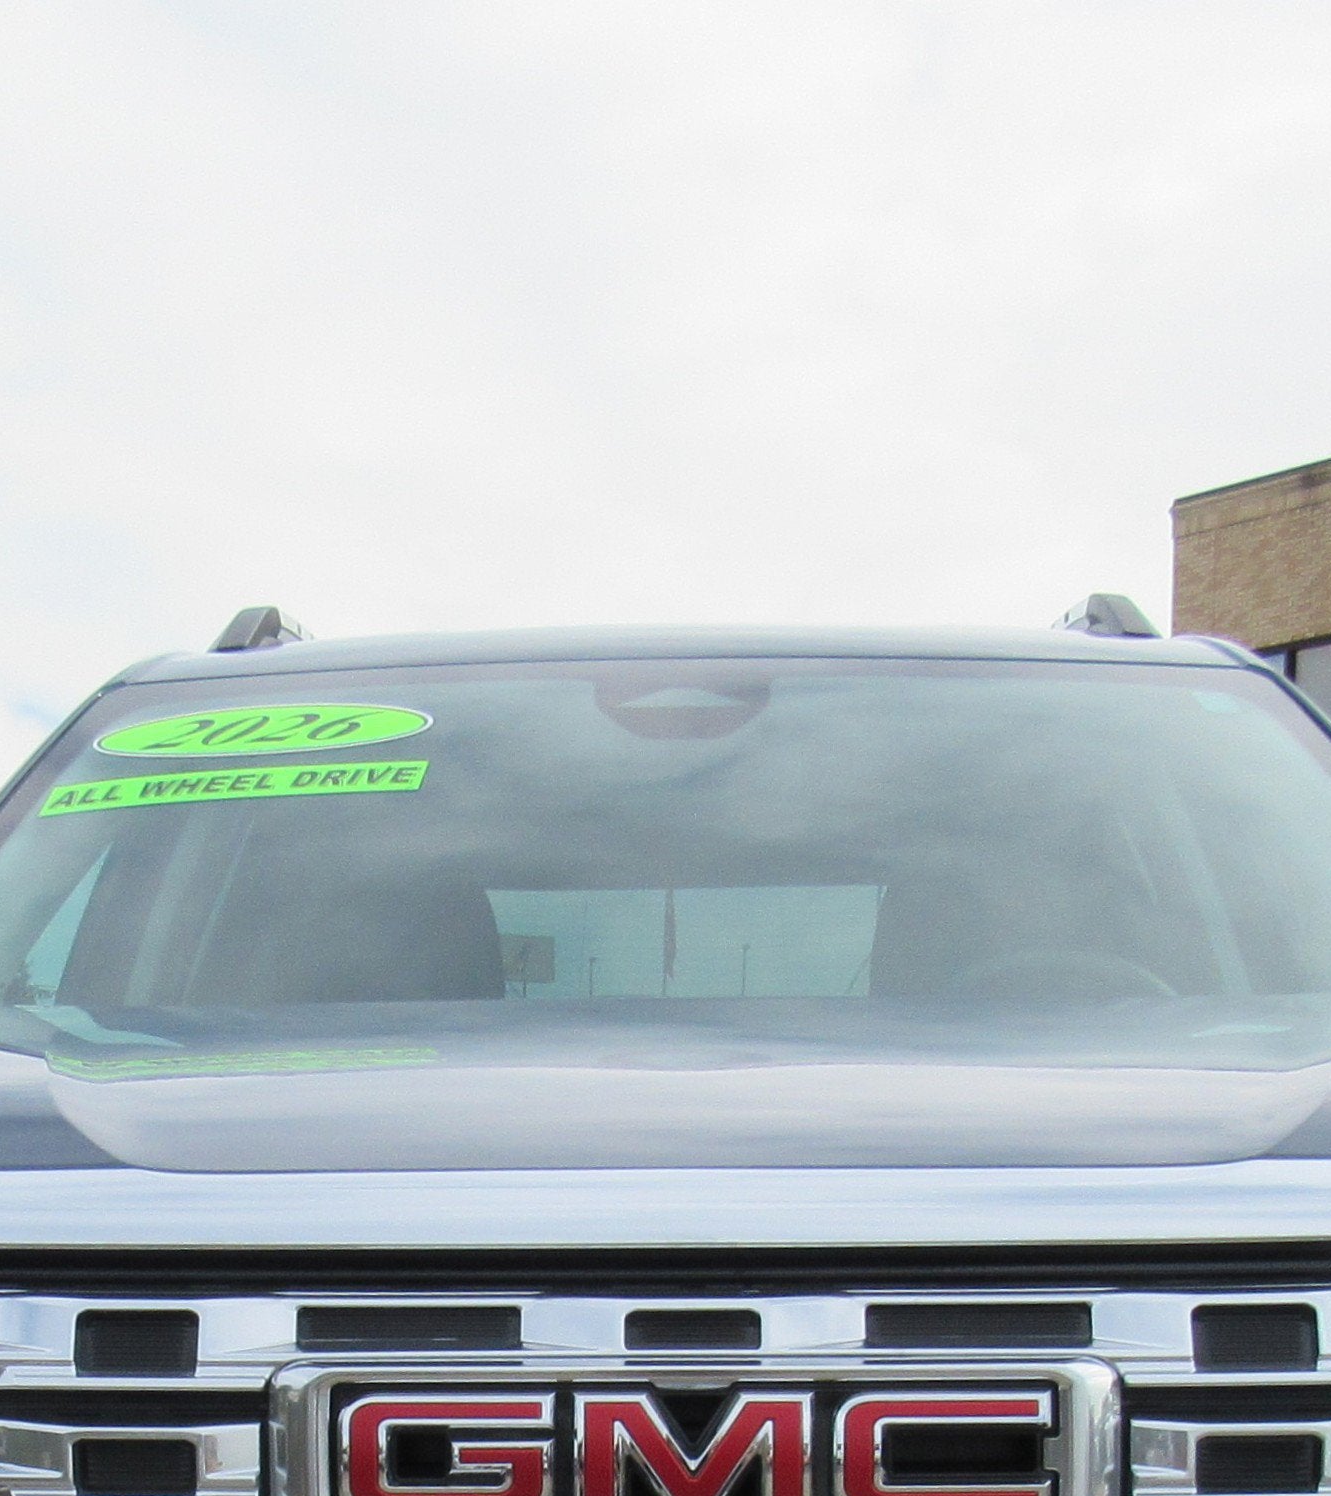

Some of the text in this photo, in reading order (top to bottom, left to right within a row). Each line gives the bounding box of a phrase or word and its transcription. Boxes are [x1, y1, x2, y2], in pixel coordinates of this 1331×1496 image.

[140, 709, 384, 751] 2026
[49, 764, 420, 809] ALL WHEEL DRIVE
